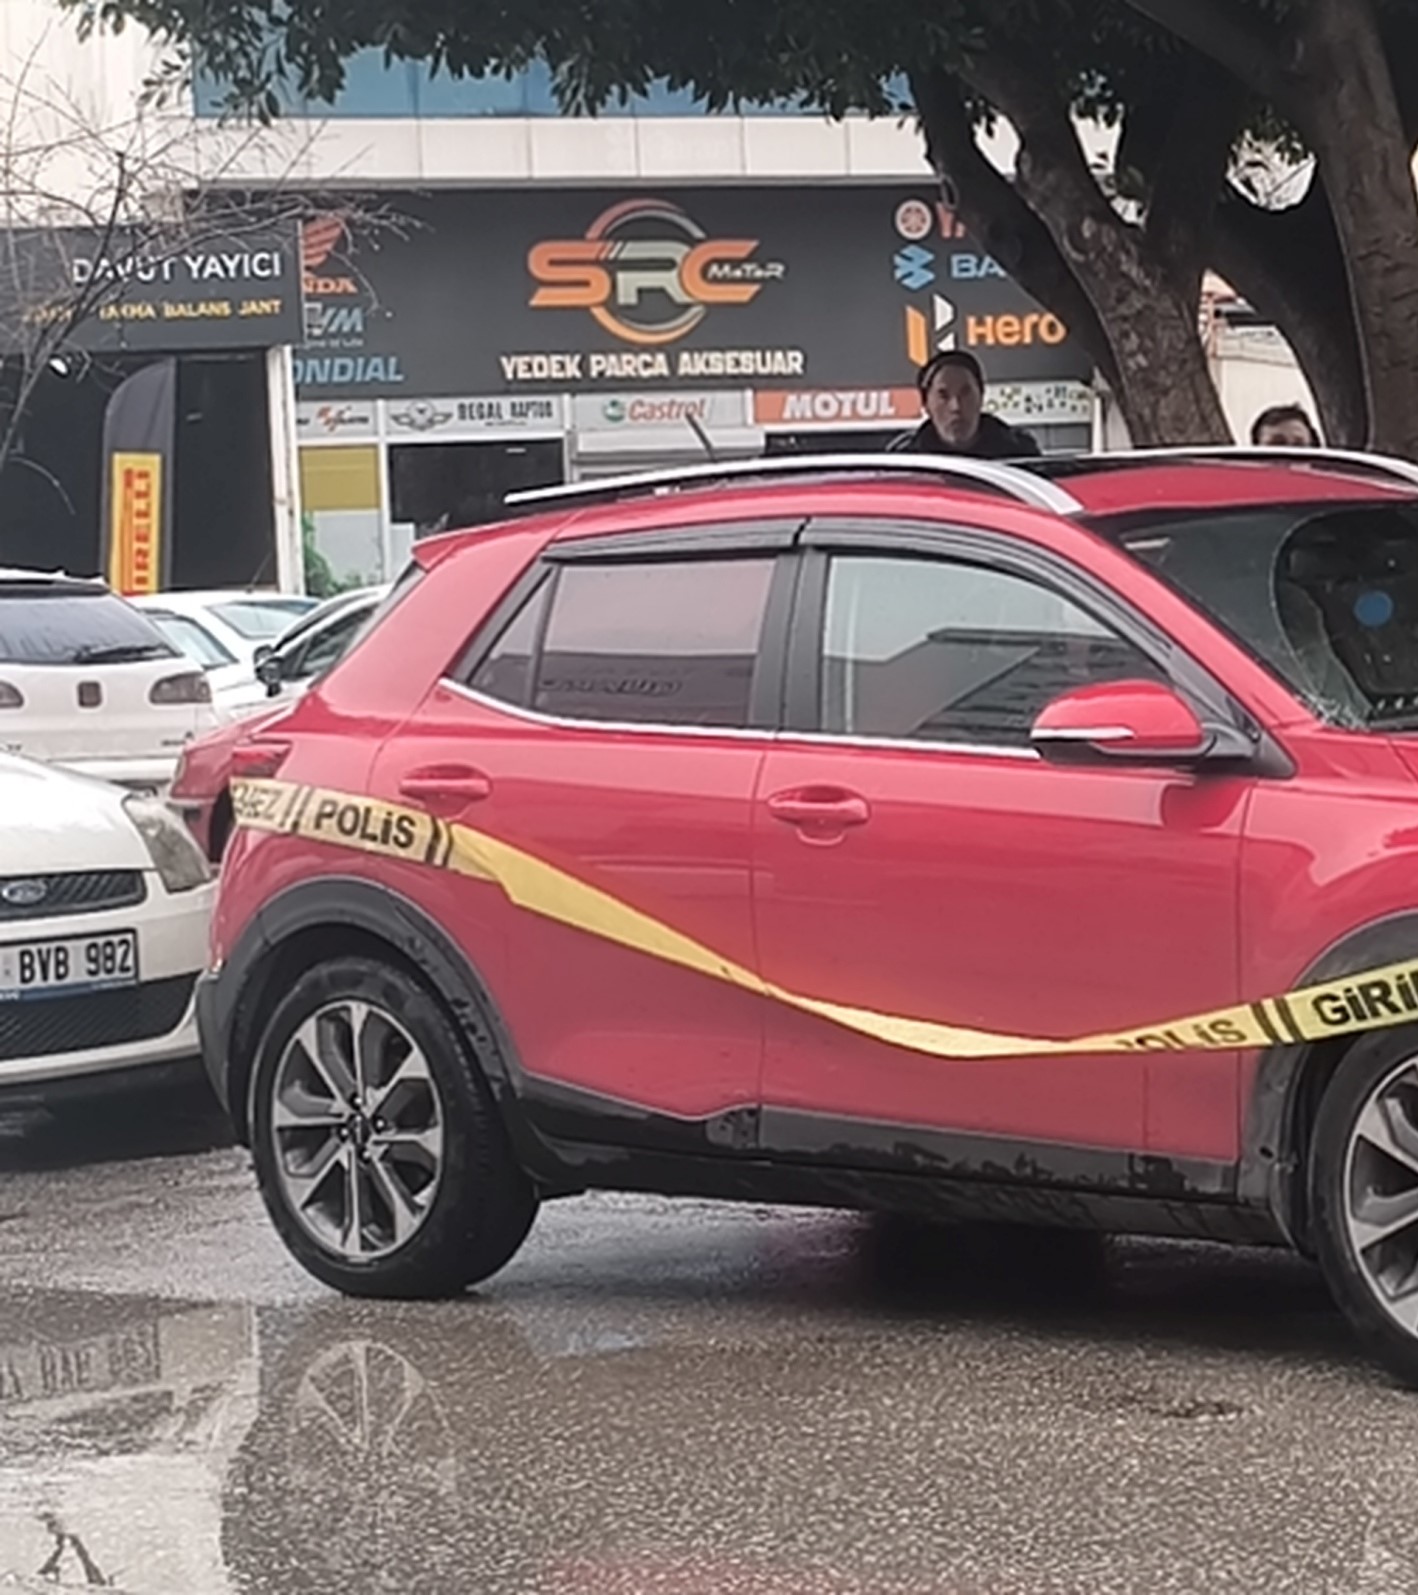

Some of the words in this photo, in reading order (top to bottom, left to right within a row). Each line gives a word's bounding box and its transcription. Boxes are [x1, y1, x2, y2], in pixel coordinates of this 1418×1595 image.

[184, 251, 281, 281] YAYICI
[527, 239, 760, 307] SRC
[951, 253, 1006, 278] BA
[294, 357, 405, 384] NDIAL
[500, 354, 582, 380] YEDEK
[590, 352, 670, 378] PARCA
[677, 350, 804, 377] AKSESUAR
[628, 398, 707, 423] Castrol
[782, 391, 896, 419] MOTUL
[19, 946, 69, 984] BVB
[85, 938, 132, 976] 982
